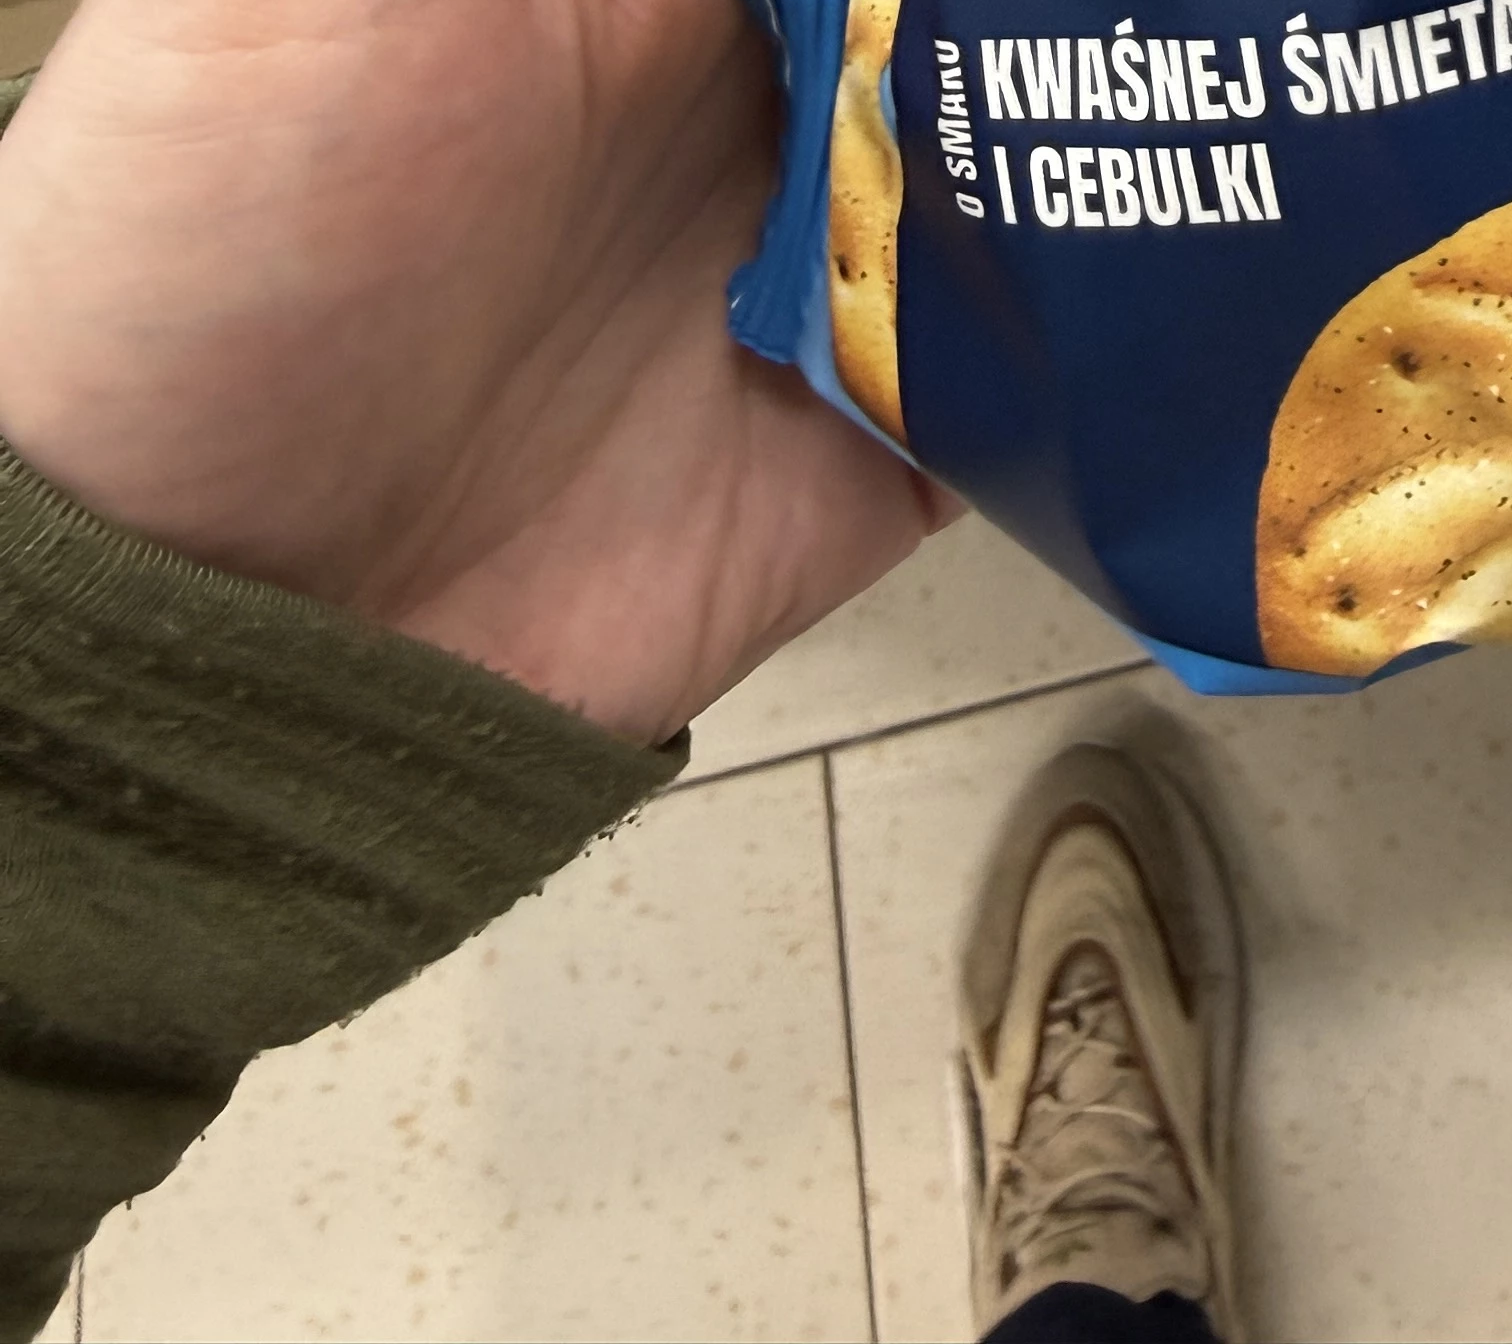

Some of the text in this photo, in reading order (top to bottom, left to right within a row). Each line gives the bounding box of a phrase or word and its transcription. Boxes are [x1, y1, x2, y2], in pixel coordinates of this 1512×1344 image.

[980, 16, 1268, 123] KWAŚNEJ
[934, 39, 985, 219] O SMAKU
[993, 142, 1283, 230] I CEBULKI
